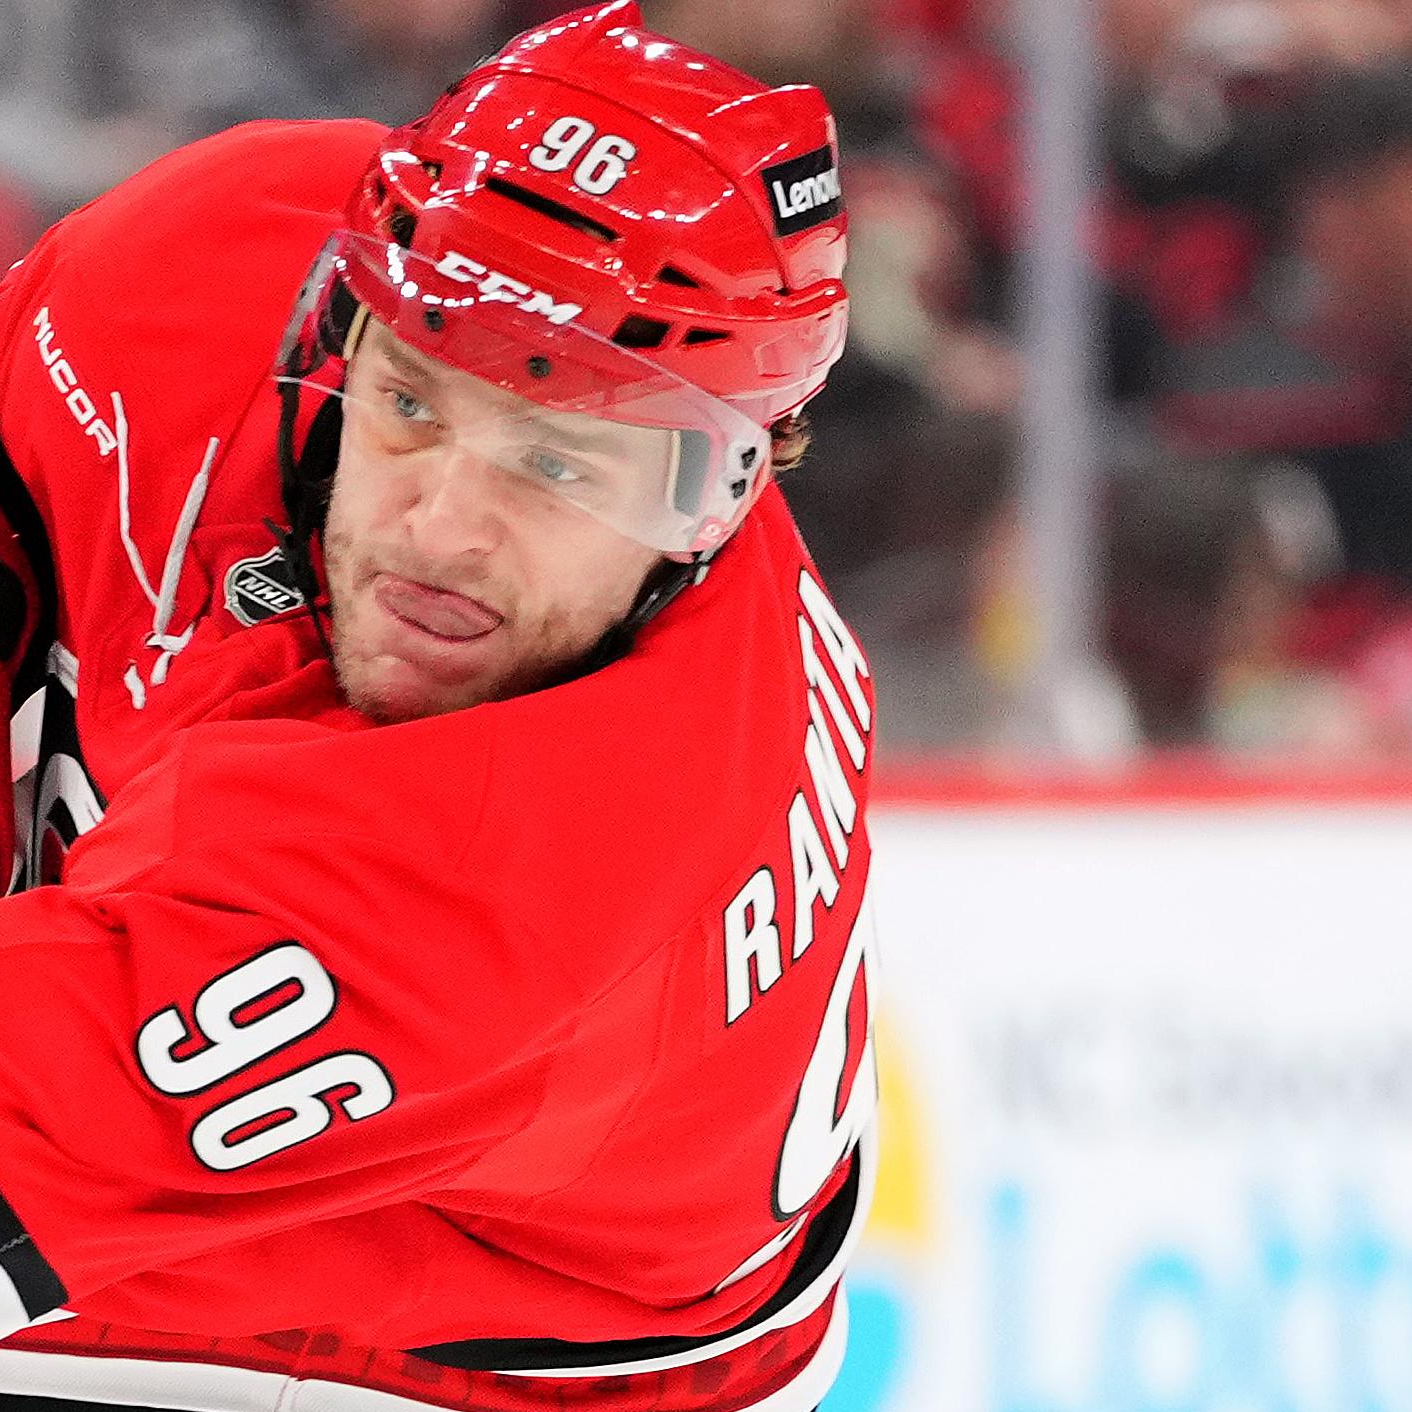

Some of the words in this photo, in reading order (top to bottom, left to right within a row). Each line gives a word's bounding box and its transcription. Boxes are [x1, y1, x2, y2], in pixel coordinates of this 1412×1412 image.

[528, 116, 638, 196] 96
[436, 251, 583, 325] CCM
[33, 307, 118, 456] NUCOR
[236, 576, 291, 608] NHL
[136, 939, 395, 1173] 96
